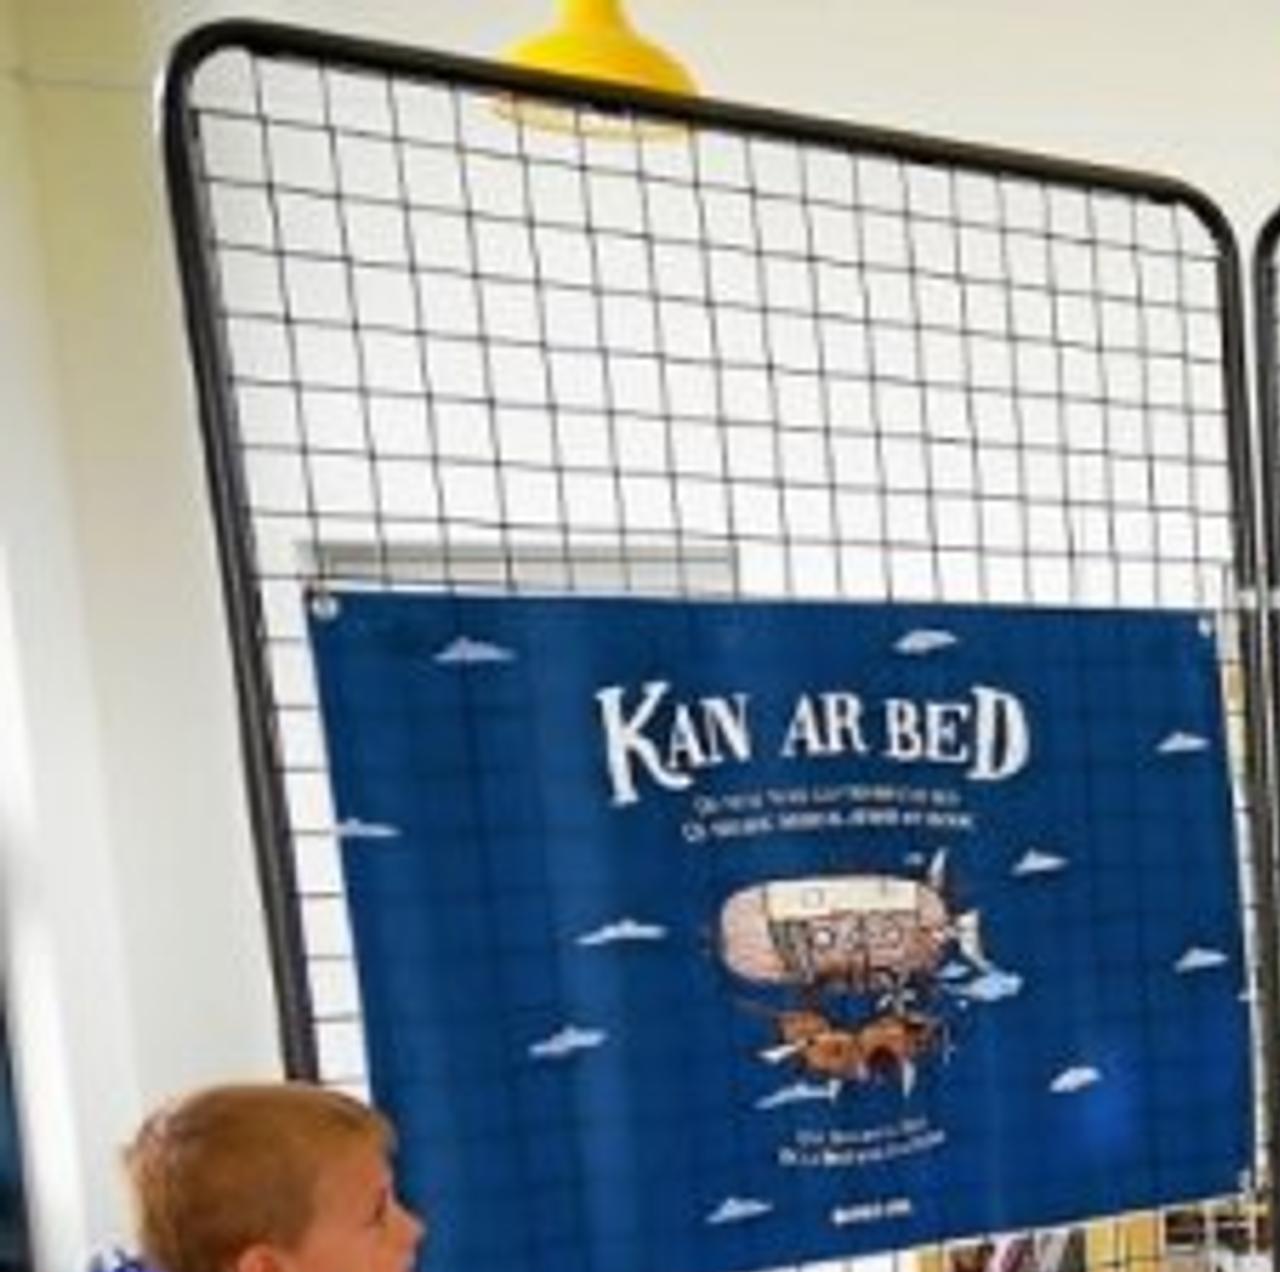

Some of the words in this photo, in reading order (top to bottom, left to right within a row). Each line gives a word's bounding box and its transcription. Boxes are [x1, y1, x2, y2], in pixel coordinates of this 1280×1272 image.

[594, 681, 752, 807] KAN
[782, 691, 867, 758] AR
[884, 685, 1031, 782] BED
